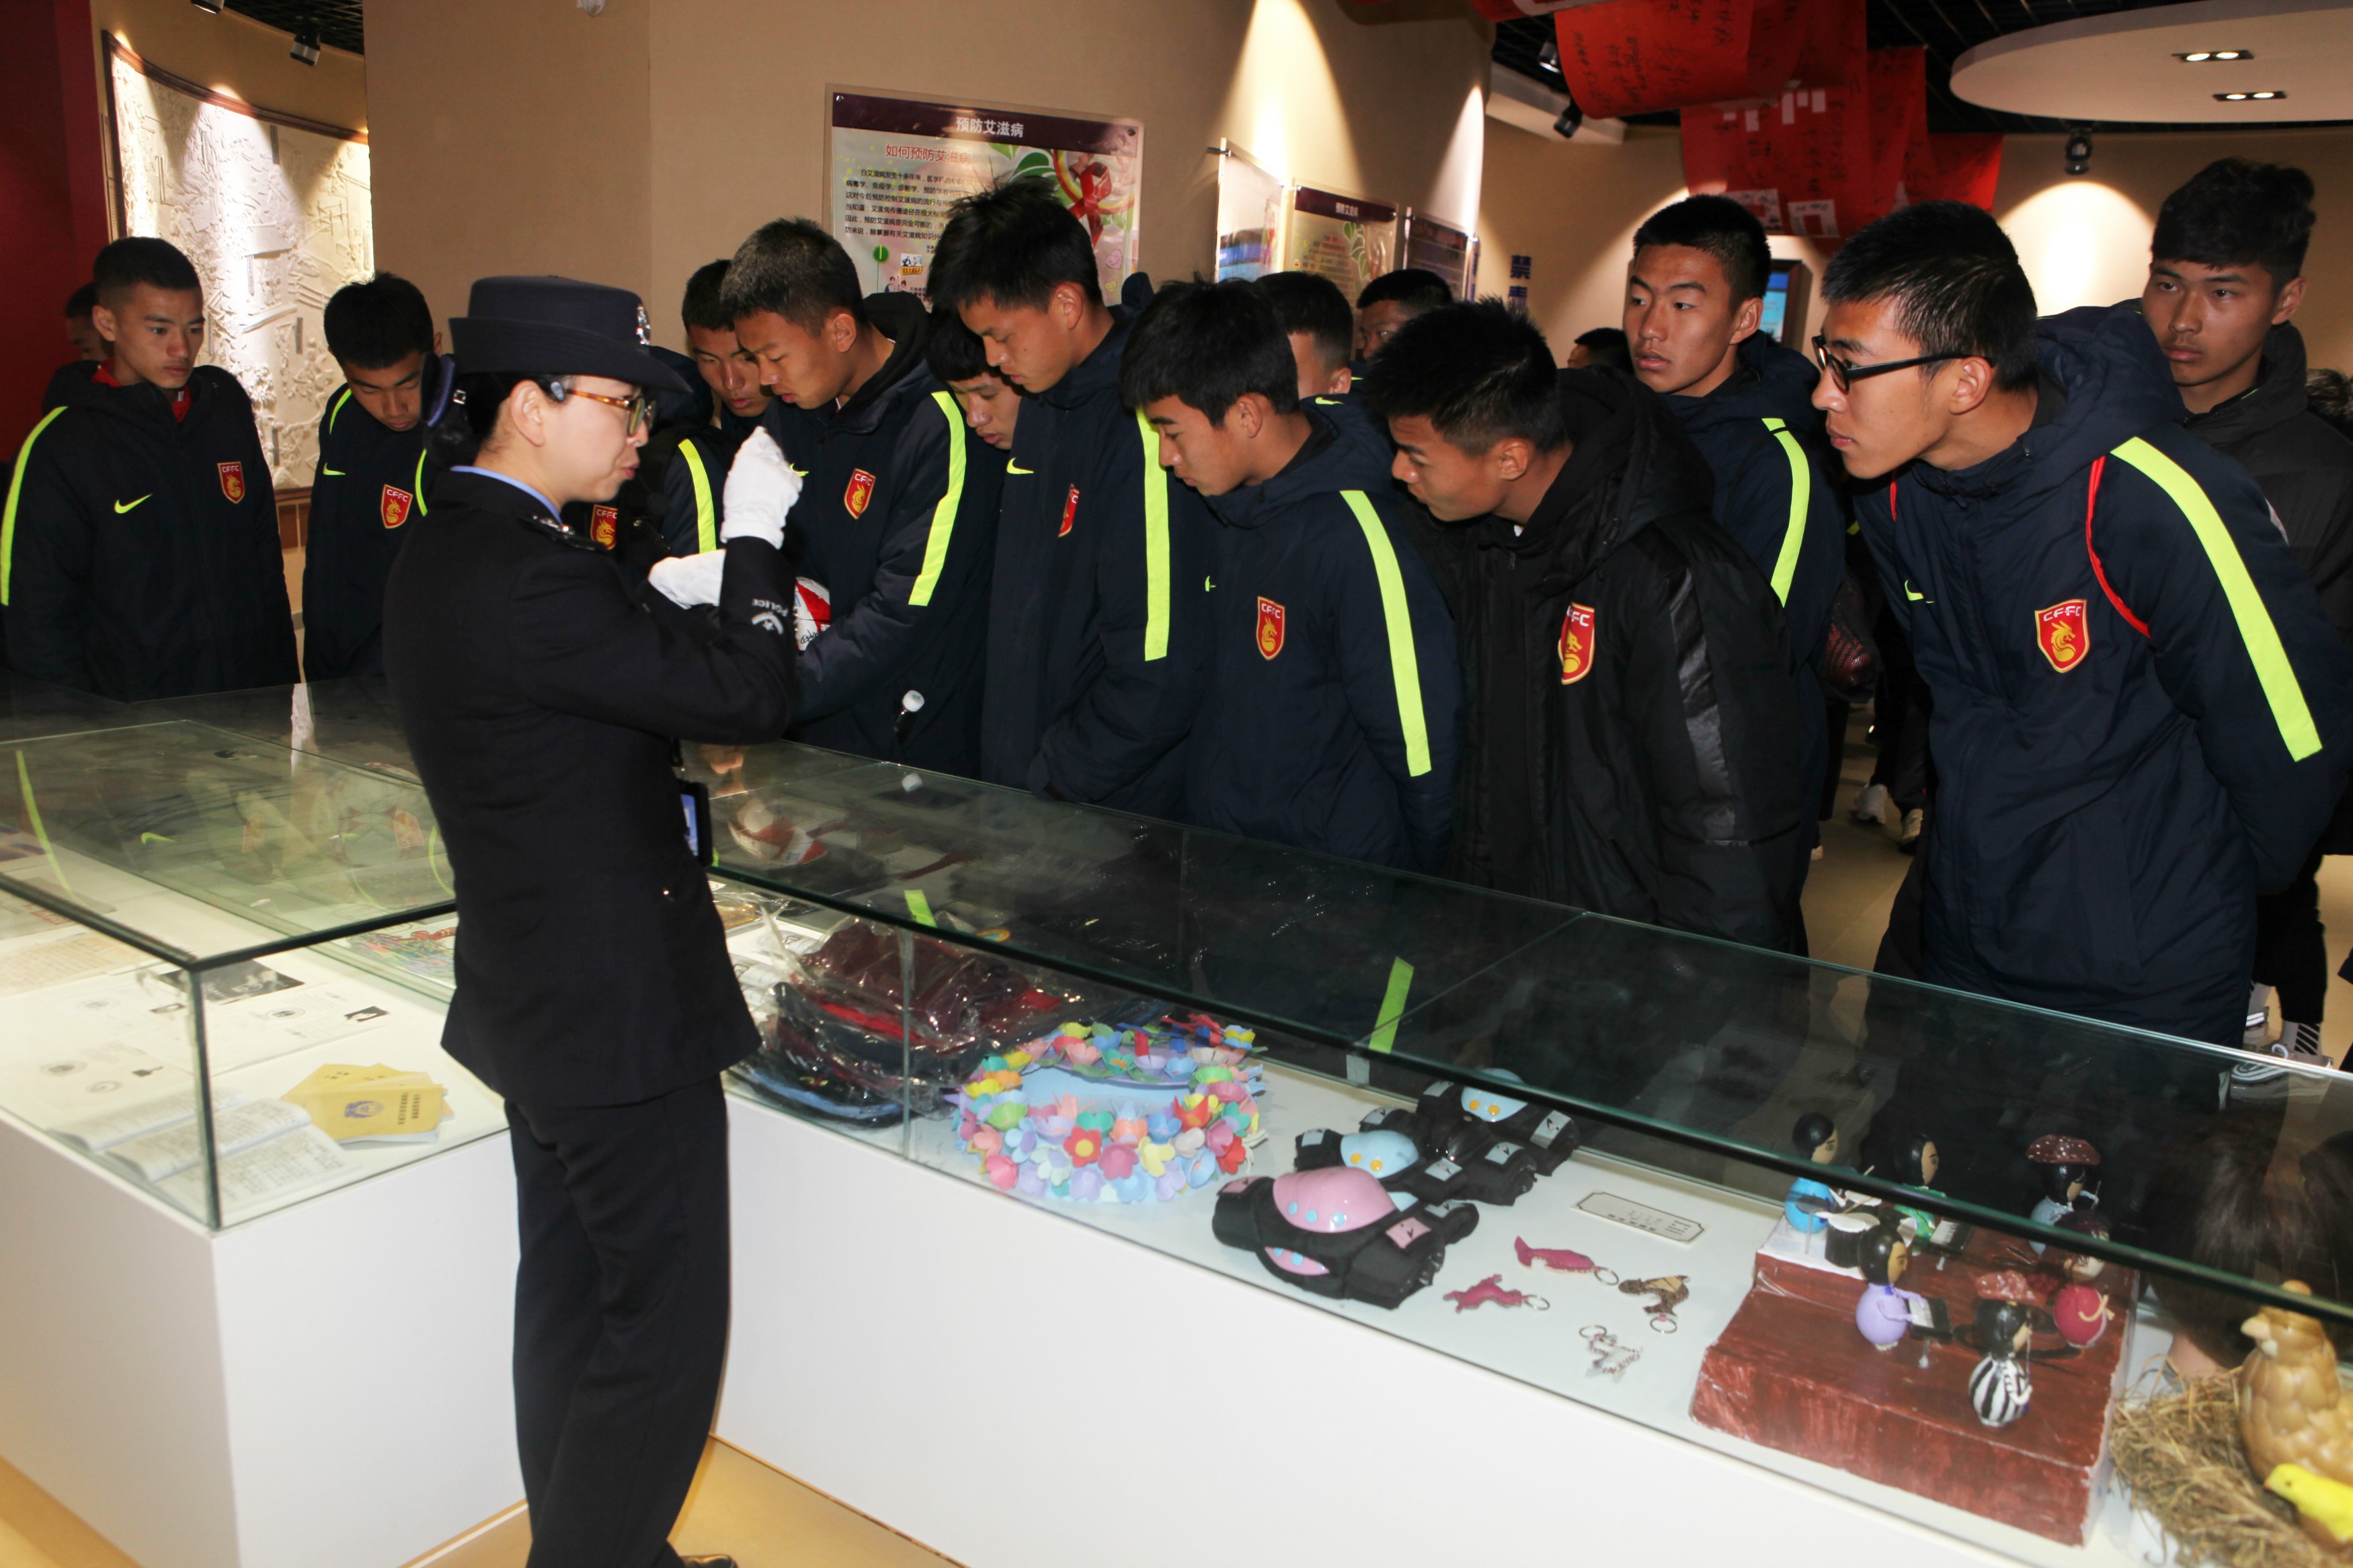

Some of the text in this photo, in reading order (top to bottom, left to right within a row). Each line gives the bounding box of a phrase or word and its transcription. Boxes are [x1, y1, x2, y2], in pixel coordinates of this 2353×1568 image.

[955, 117, 1024, 138] 预防艾滋病
[885, 143, 971, 165] 如何预防艾滋病
[222, 465, 239, 473] CFFC
[387, 489, 409, 502] CFFC
[596, 509, 618, 519] CFFC
[752, 597, 789, 617] POLICE
[2043, 606, 2081, 622] CFFC
